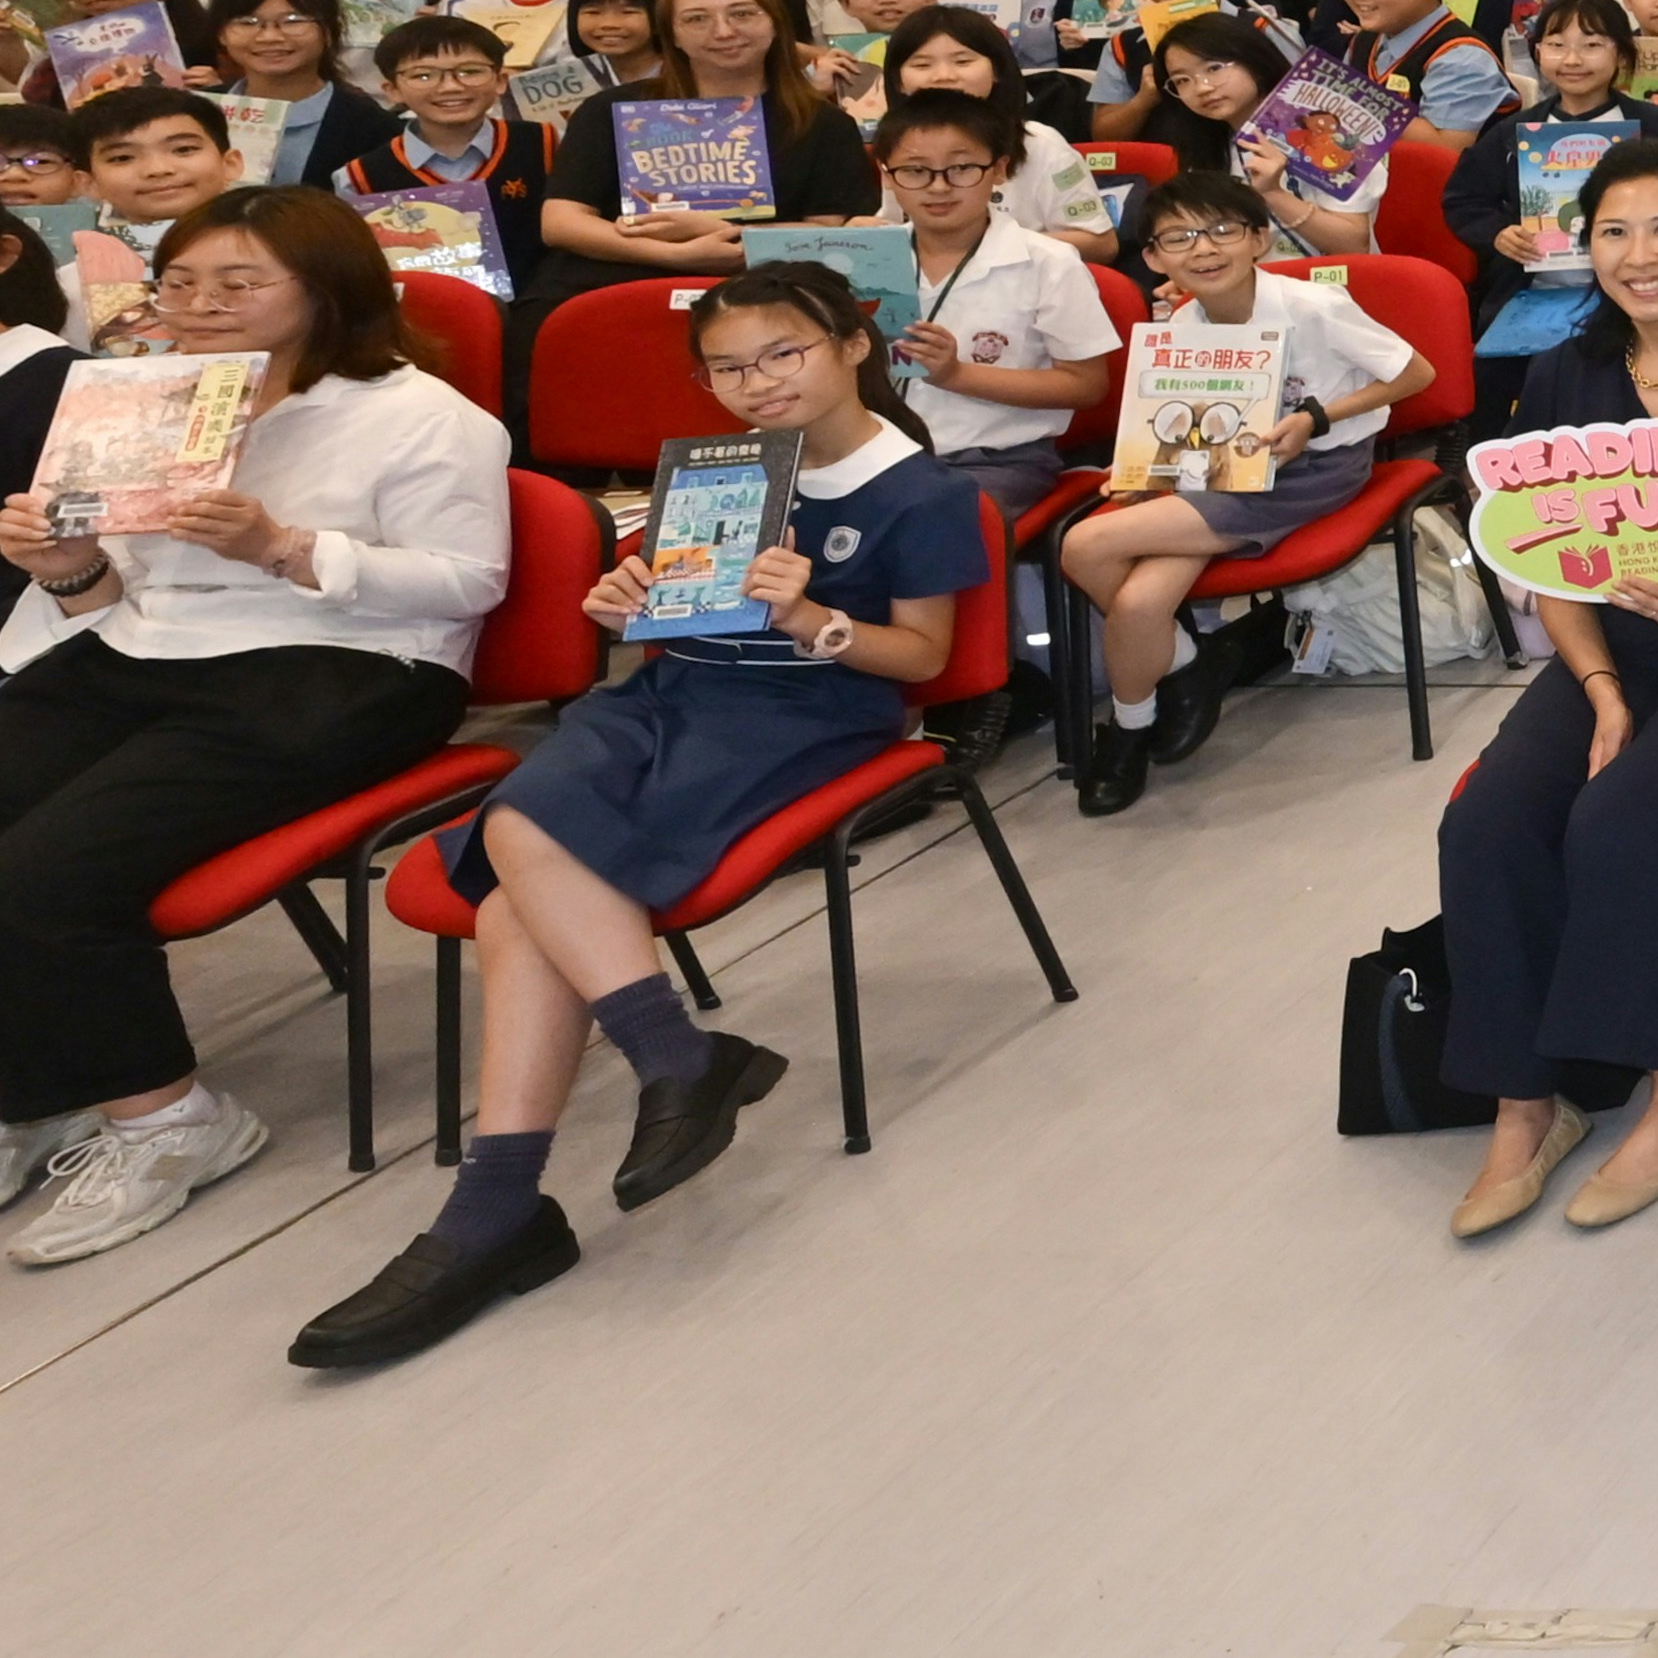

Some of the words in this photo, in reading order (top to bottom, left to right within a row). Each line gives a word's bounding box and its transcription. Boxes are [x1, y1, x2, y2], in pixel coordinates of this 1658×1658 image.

[522, 78, 584, 106] DOG
[631, 139, 750, 173] BEDTIME
[648, 158, 758, 188] STORIES
[1314, 271, 1343, 283] P-01
[1150, 346, 1273, 373] 真正的朋友?
[1531, 488, 1583, 526] IS
[1618, 557, 1652, 569] HONG
[1620, 564, 1658, 578] READING
